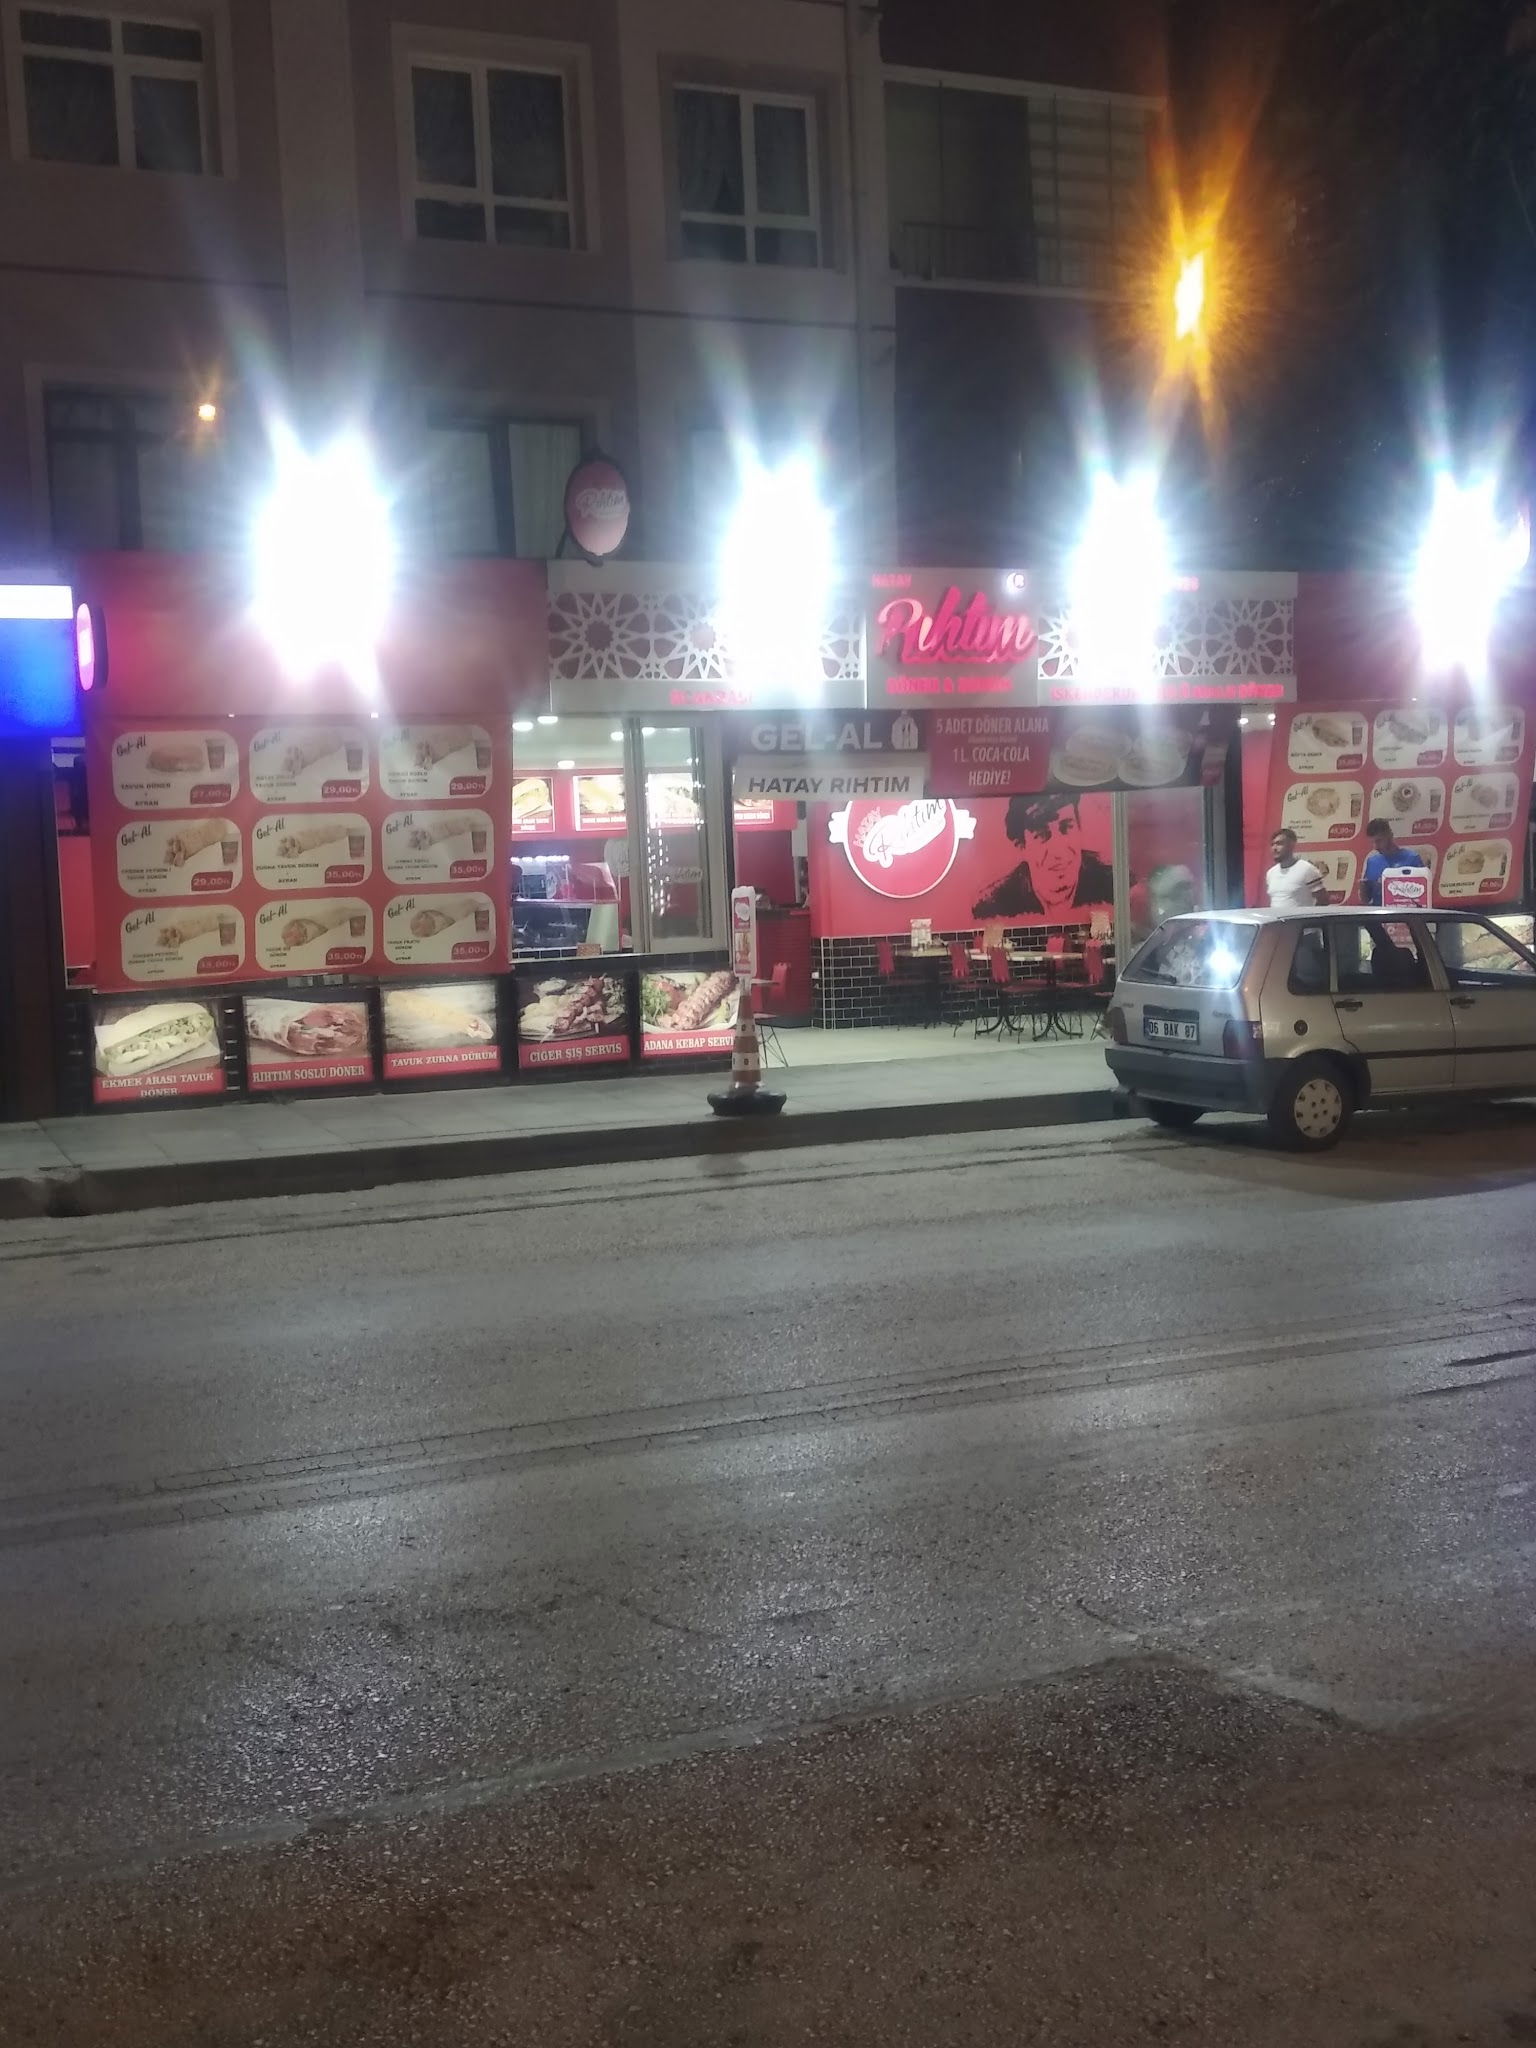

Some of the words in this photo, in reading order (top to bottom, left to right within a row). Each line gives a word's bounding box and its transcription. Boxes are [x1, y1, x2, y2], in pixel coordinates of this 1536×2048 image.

[936, 718, 943, 734] 5
[945, 717, 973, 734] ADET
[976, 714, 1012, 733] DÖNER
[1014, 717, 1049, 733] ALANA
[751, 721, 883, 750] GEL-AL
[953, 748, 958, 762] 1
[748, 776, 822, 793] HATAY
[831, 776, 910, 793] RIHTIM
[968, 767, 1011, 786] HEDİYE!
[1149, 1021, 1159, 1034] 06
[1164, 1022, 1178, 1038] BAK
[1185, 1024, 1195, 1038] 87
[644, 1040, 673, 1050] ADANA
[676, 1038, 706, 1048] KEBAP
[392, 1058, 423, 1067] TAVUK
[426, 1055, 459, 1064] ZURNA
[102, 1078, 142, 1088] EKMEK
[145, 1075, 177, 1085] ARASI
[181, 1072, 214, 1082] TAVUK
[252, 1070, 291, 1082] RIHTIM
[294, 1068, 327, 1079] SOSLU
[329, 1064, 365, 1077] DÖNER
[141, 1086, 178, 1097] DÖNER
